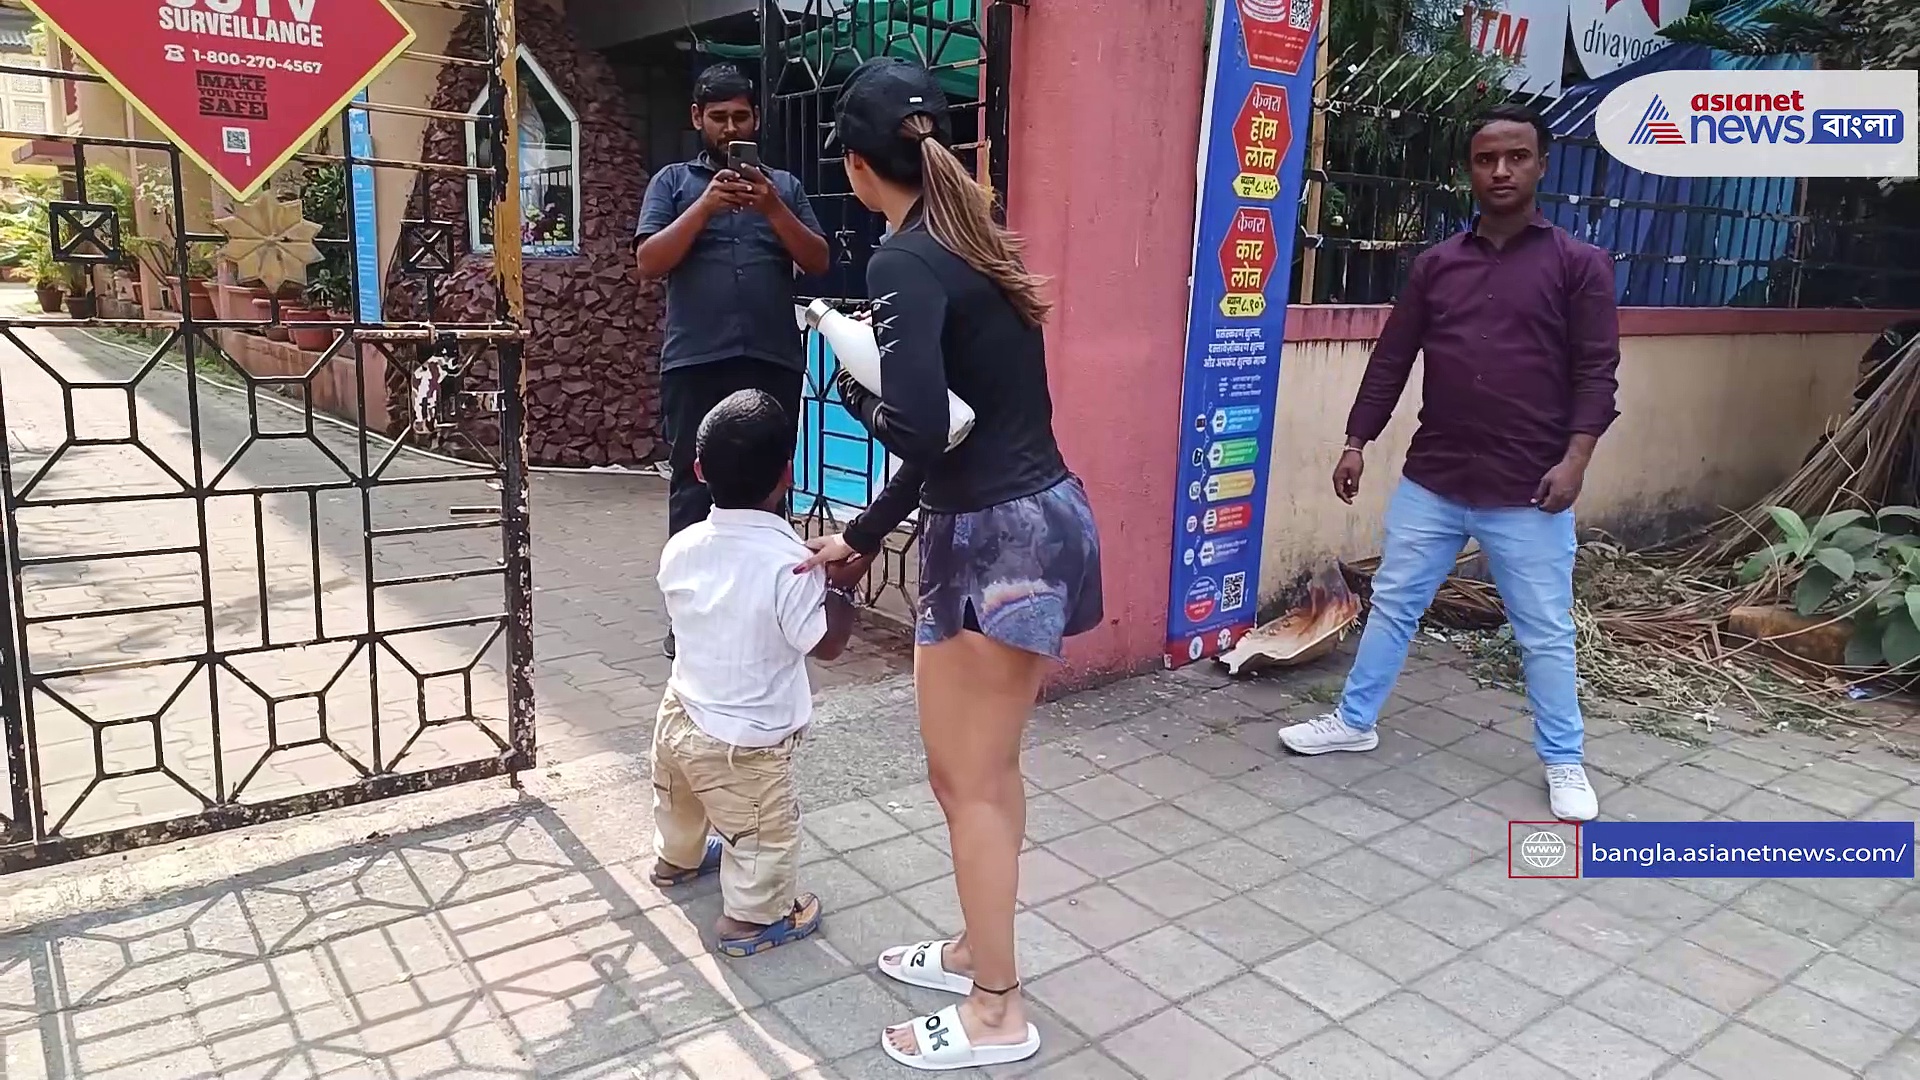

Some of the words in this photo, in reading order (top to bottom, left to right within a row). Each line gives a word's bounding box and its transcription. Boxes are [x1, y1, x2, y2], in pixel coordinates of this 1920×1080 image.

[158, 6, 323, 47] SURVEILLANCE
[192, 49, 323, 74] 1-800-270-4567
[198, 87, 235, 98] YOUR
[235, 91, 267, 101] CITY
[202, 75, 267, 92] MAKE
[199, 97, 263, 114] SAFE
[1252, 87, 1281, 112] केनरा
[1250, 110, 1279, 141] होम
[1245, 140, 1277, 170] लोन
[1237, 211, 1266, 233] केनरा
[1235, 239, 1265, 261] कार
[1231, 261, 1262, 288] लोन
